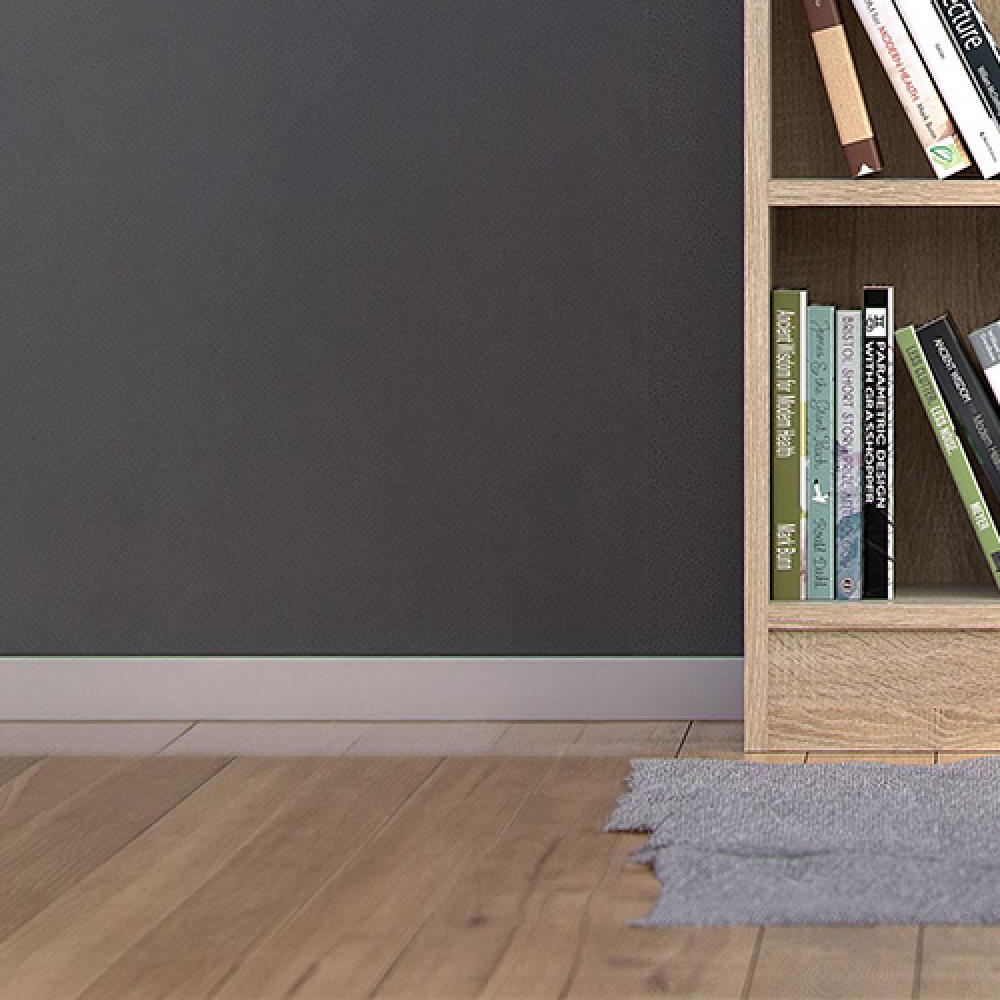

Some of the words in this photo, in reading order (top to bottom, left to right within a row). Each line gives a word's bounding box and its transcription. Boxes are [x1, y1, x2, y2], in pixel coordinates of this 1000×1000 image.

[776, 310, 795, 342] Ancient
[841, 316, 854, 362] BRISTOL
[776, 343, 795, 377] Wisdom
[865, 341, 874, 382] WITH
[934, 336, 955, 370] ANCIENT
[951, 370, 971, 403] WISDOM
[776, 379, 795, 391] for
[841, 368, 854, 408] SHORT
[875, 341, 886, 445] PARAMETRIC
[776, 394, 795, 427] Modern
[776, 430, 795, 457] Health
[865, 386, 874, 502] GRASSHOPPER
[875, 449, 886, 508] DESIGN
[776, 523, 796, 545] Mark
[812, 518, 826, 552] Roald
[813, 557, 828, 589] Dahl
